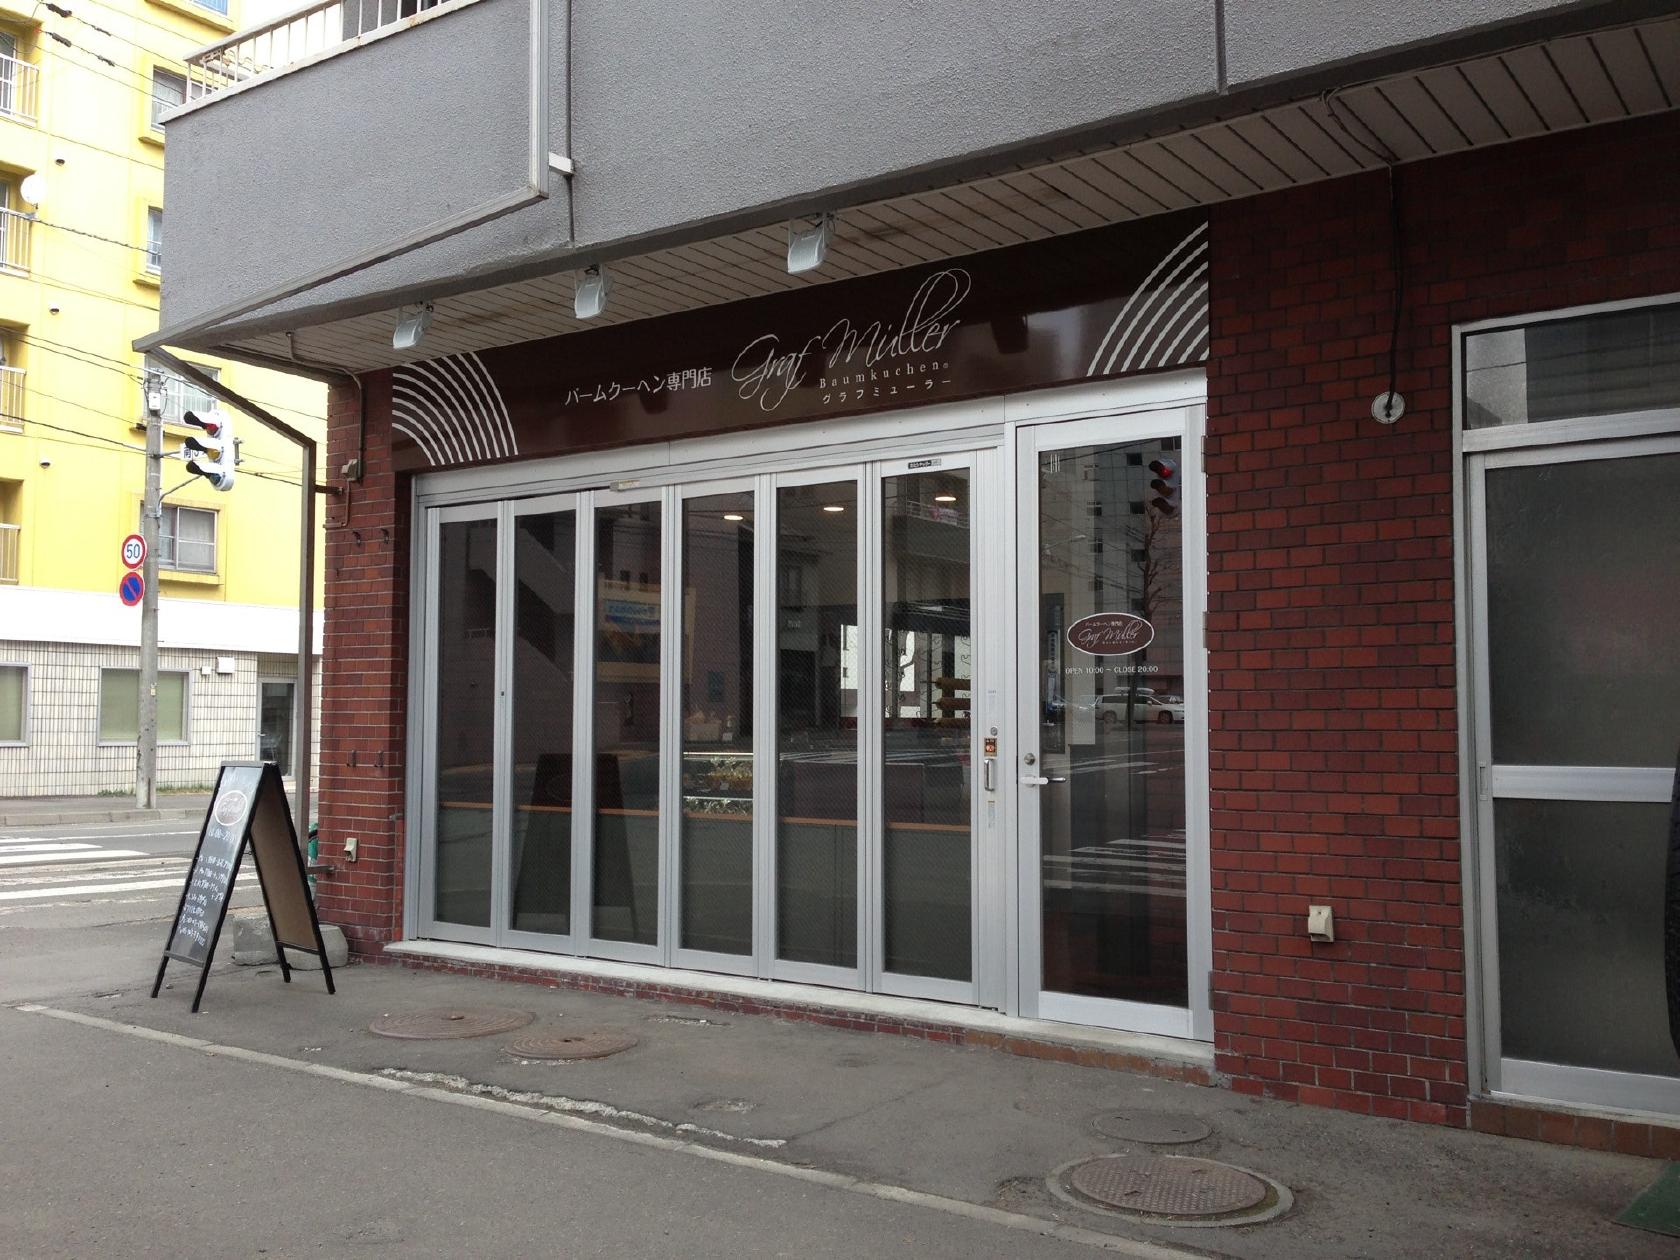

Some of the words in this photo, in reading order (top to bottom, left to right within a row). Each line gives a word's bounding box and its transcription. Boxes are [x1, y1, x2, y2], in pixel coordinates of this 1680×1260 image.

[565, 366, 713, 405] バームクーヘン専門店
[732, 334, 821, 411] Graf
[823, 378, 952, 405] グラフミューラー
[126, 543, 141, 559] 50
[1065, 667, 1083, 675] OPEN
[1113, 665, 1136, 673] CLOSE
